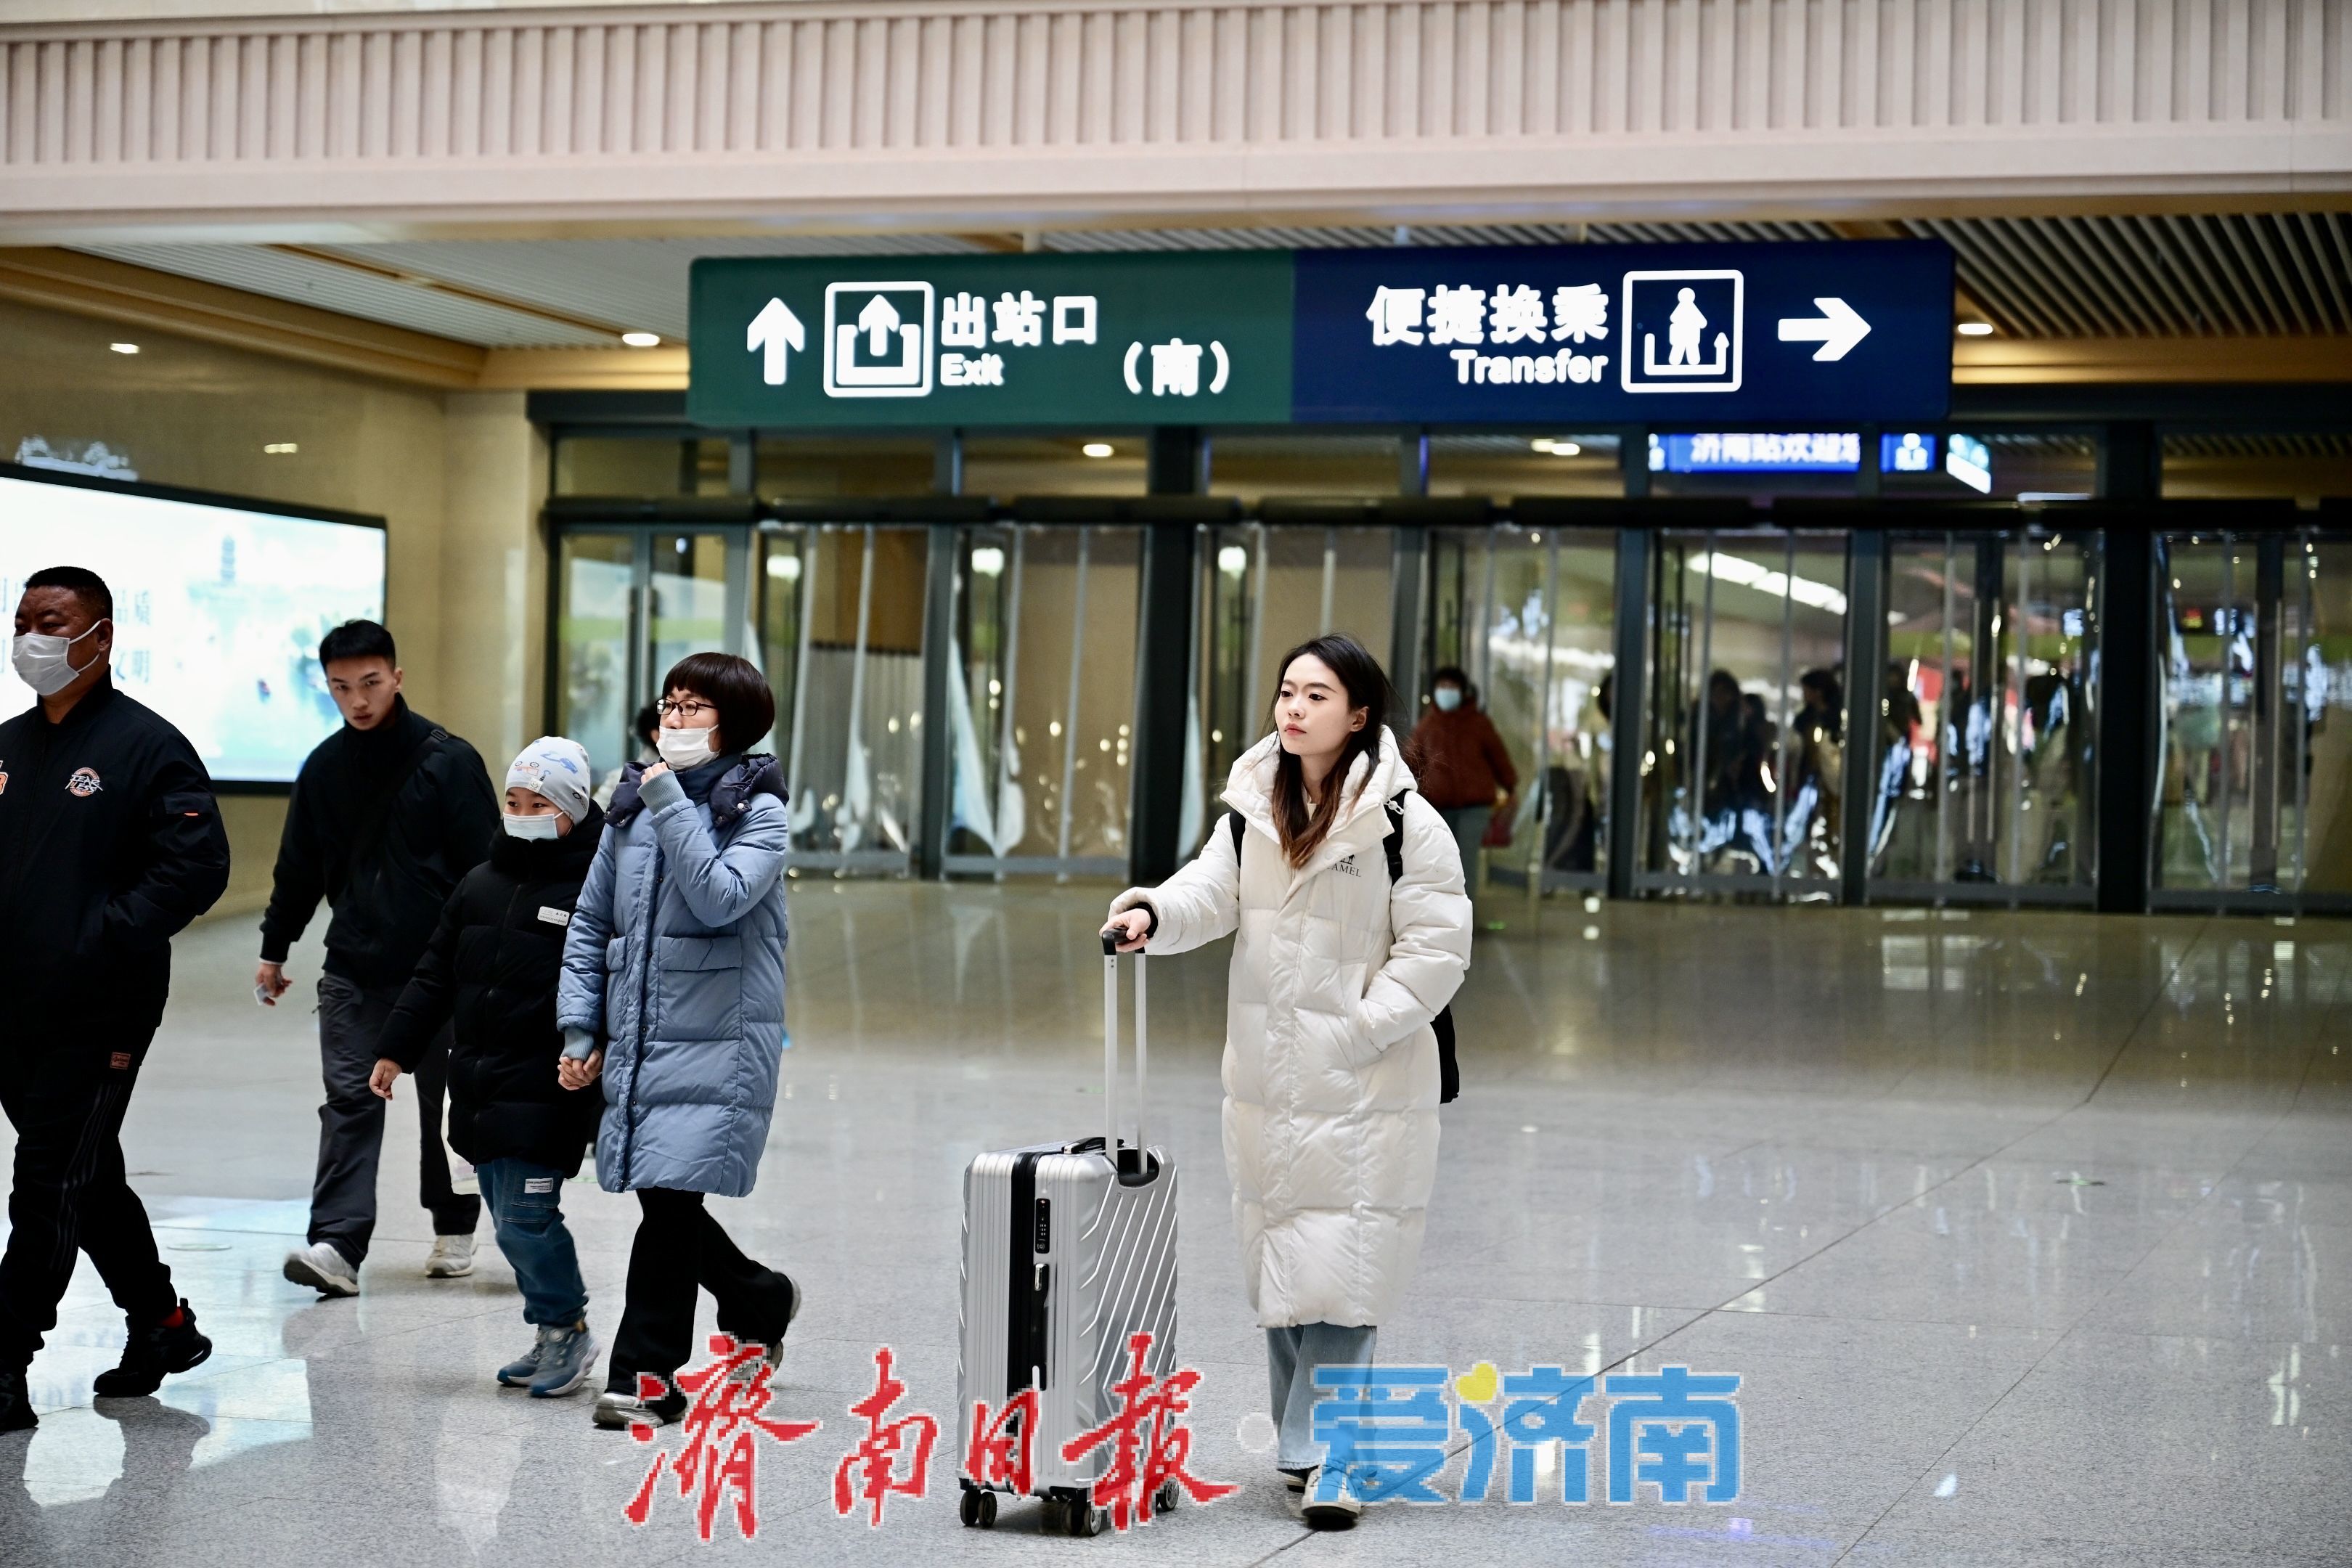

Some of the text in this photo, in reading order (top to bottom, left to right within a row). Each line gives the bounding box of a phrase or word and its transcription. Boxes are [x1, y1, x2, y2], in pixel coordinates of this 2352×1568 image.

[941, 290, 1098, 348] 出站口
[1365, 283, 1609, 346] 便捷换乘
[940, 353, 1005, 387] Exit
[1450, 348, 1609, 385] Transfer
[1327, 863, 1362, 878] AMEL
